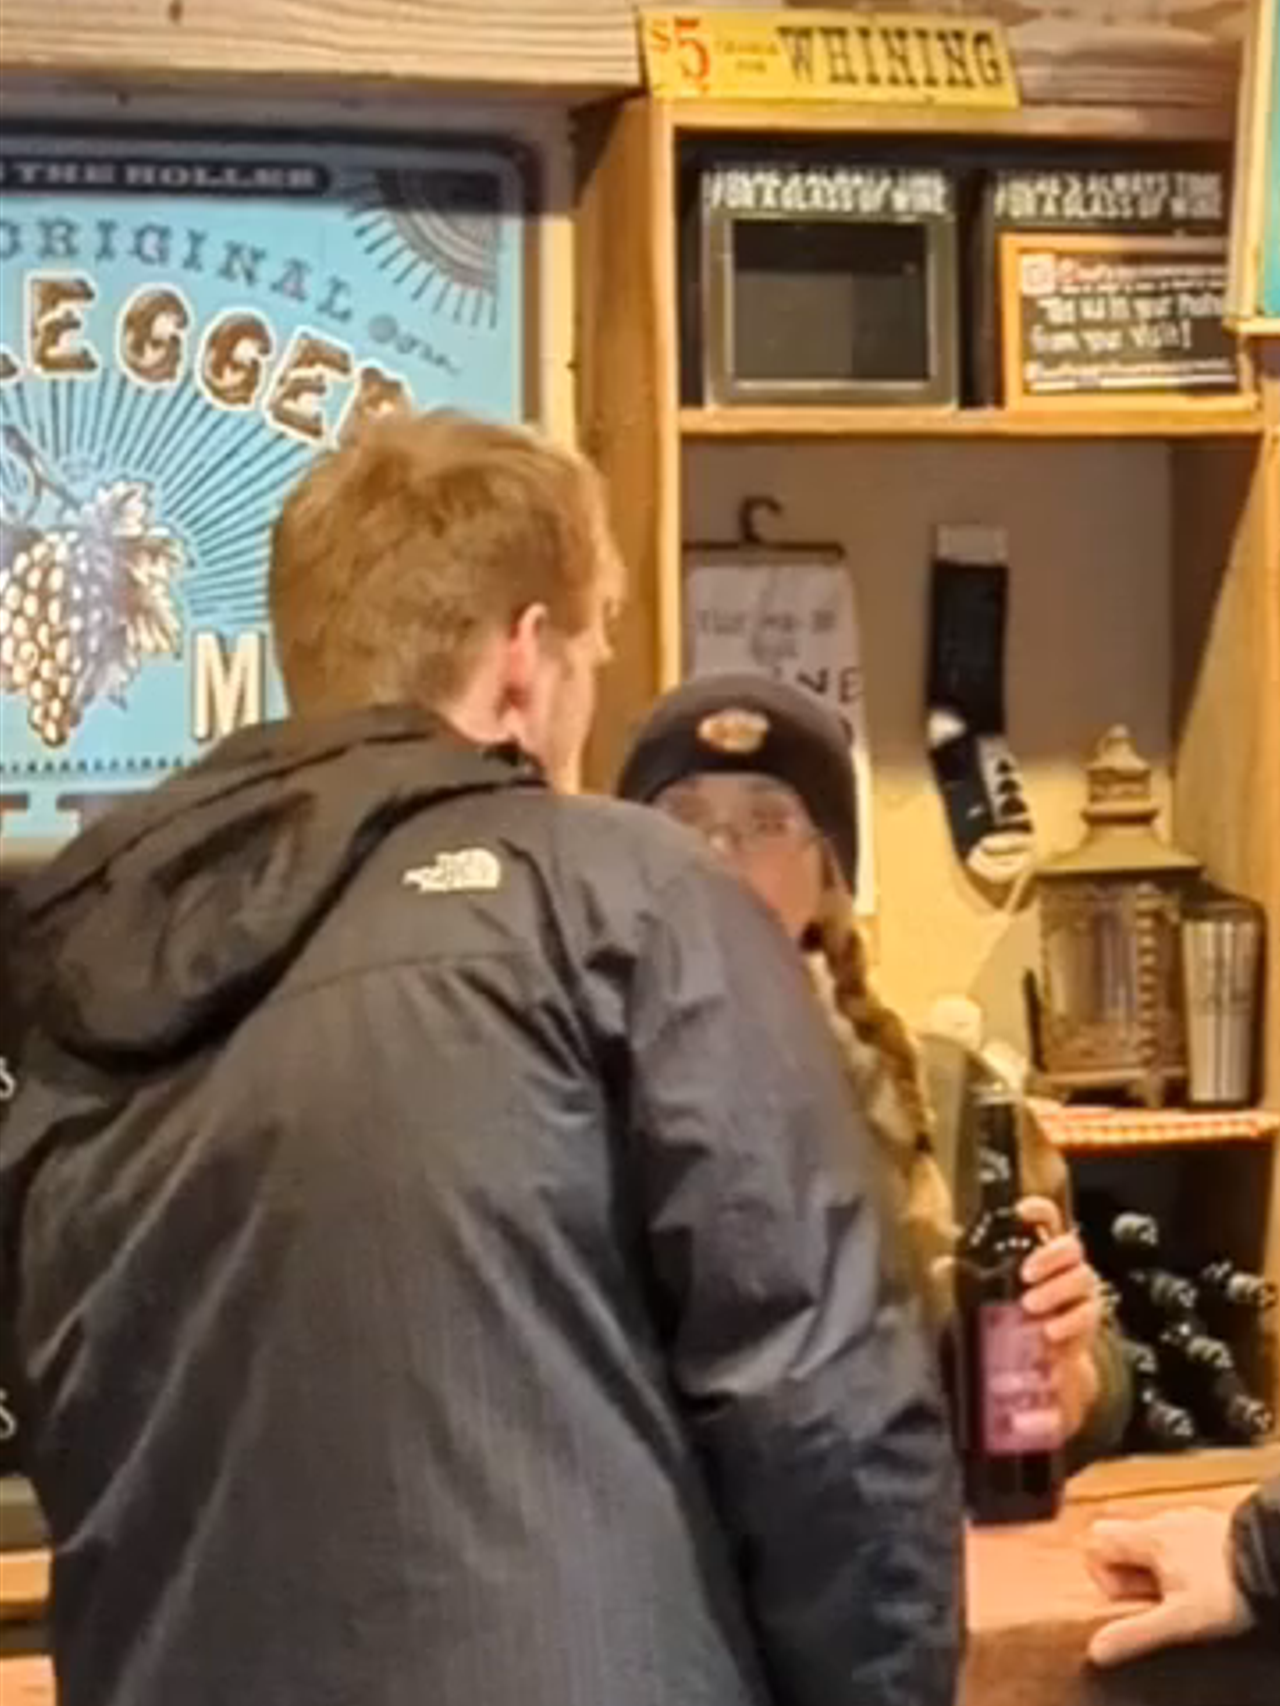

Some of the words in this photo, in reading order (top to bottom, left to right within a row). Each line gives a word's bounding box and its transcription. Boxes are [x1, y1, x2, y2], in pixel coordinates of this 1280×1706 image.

[776, 24, 1003, 89] WHINING
[16, 162, 114, 184] THE
[125, 163, 316, 187] HOLLER
